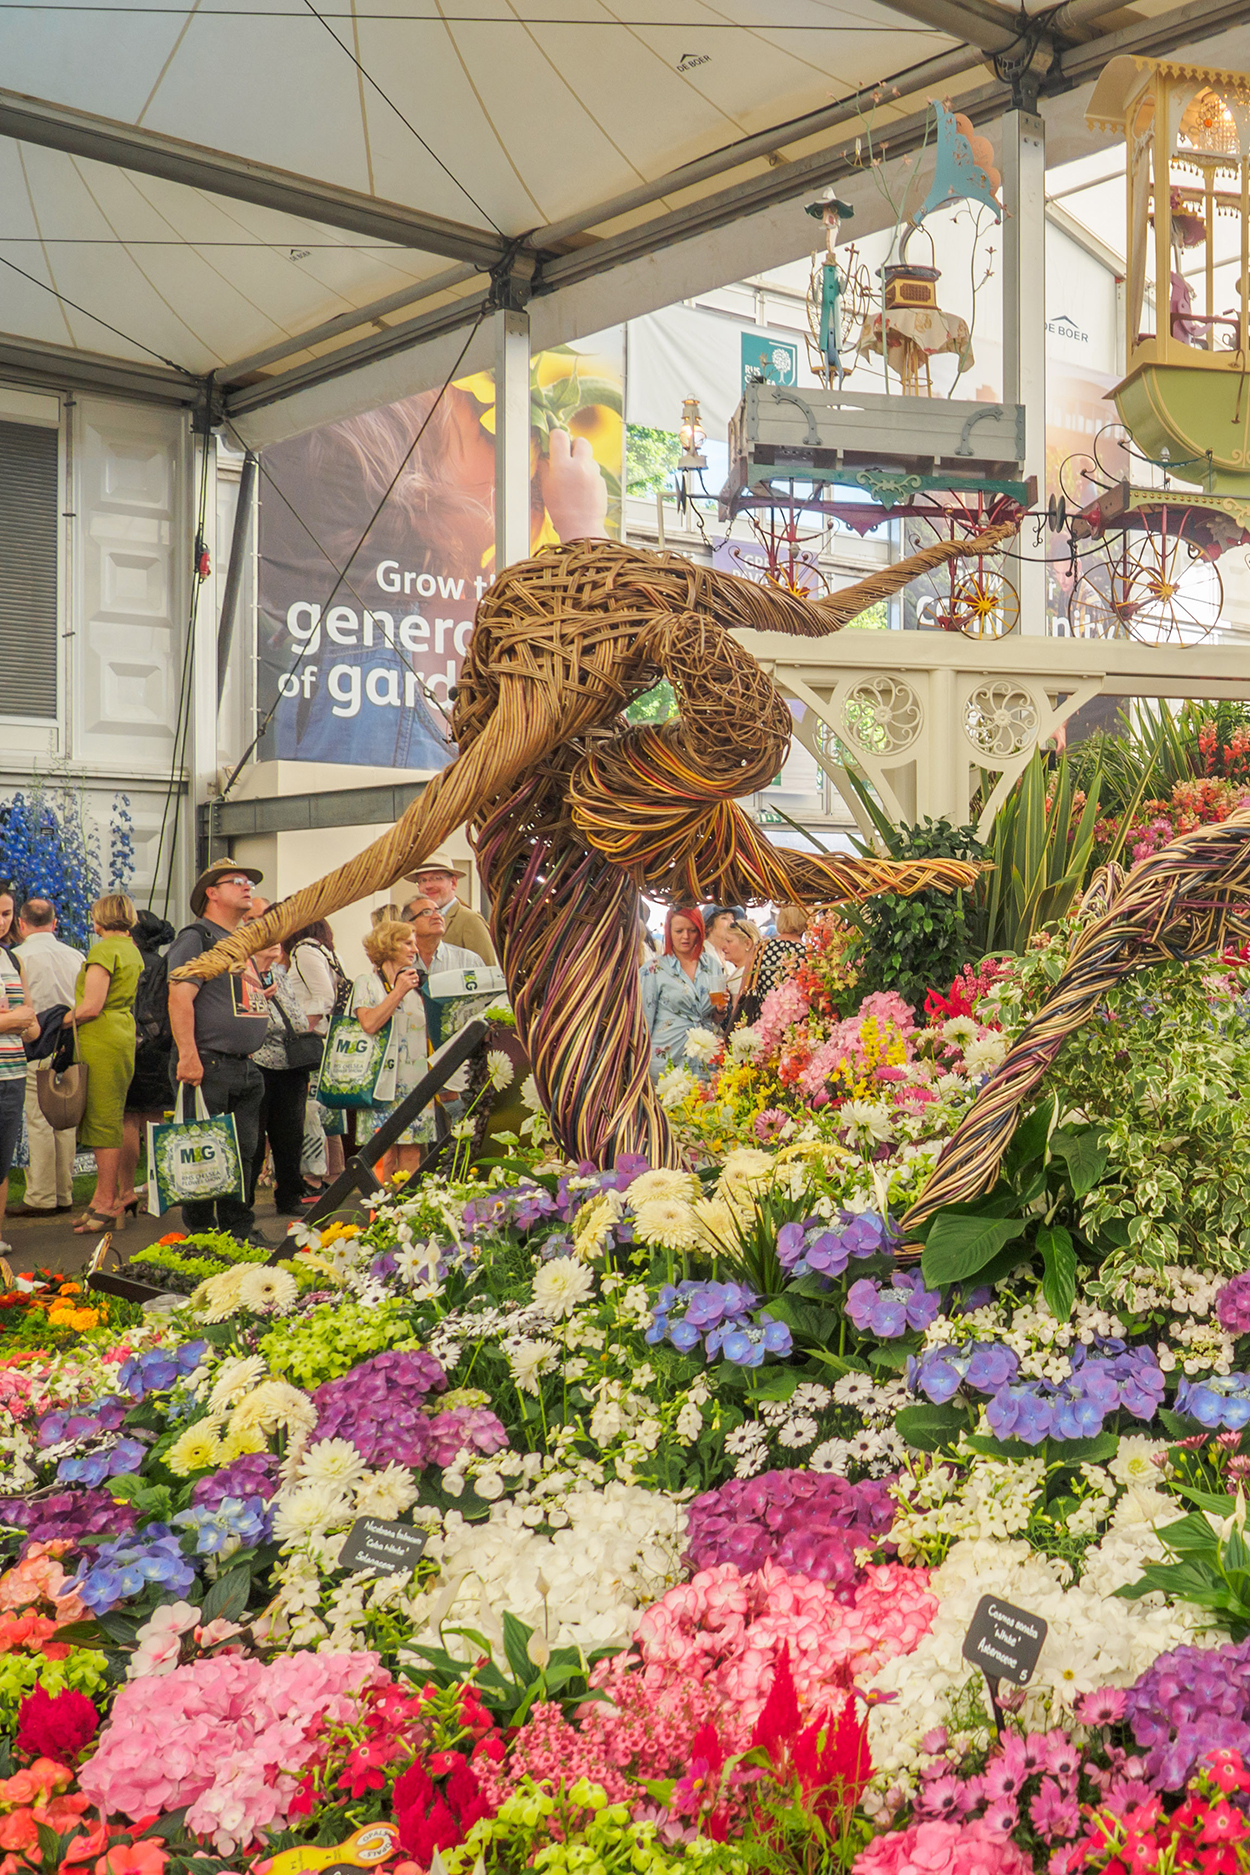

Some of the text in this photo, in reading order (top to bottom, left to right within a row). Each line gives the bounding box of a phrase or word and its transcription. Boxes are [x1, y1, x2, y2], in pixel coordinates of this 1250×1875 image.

[676, 54, 713, 73] DE BOER
[1058, 325, 1088, 343] BOER
[376, 560, 465, 600] Grow
[278, 665, 318, 699] of
[180, 1145, 215, 1164] M&G
[988, 1604, 1015, 1628] Cosmos
[1019, 1669, 1028, 1681] 5
